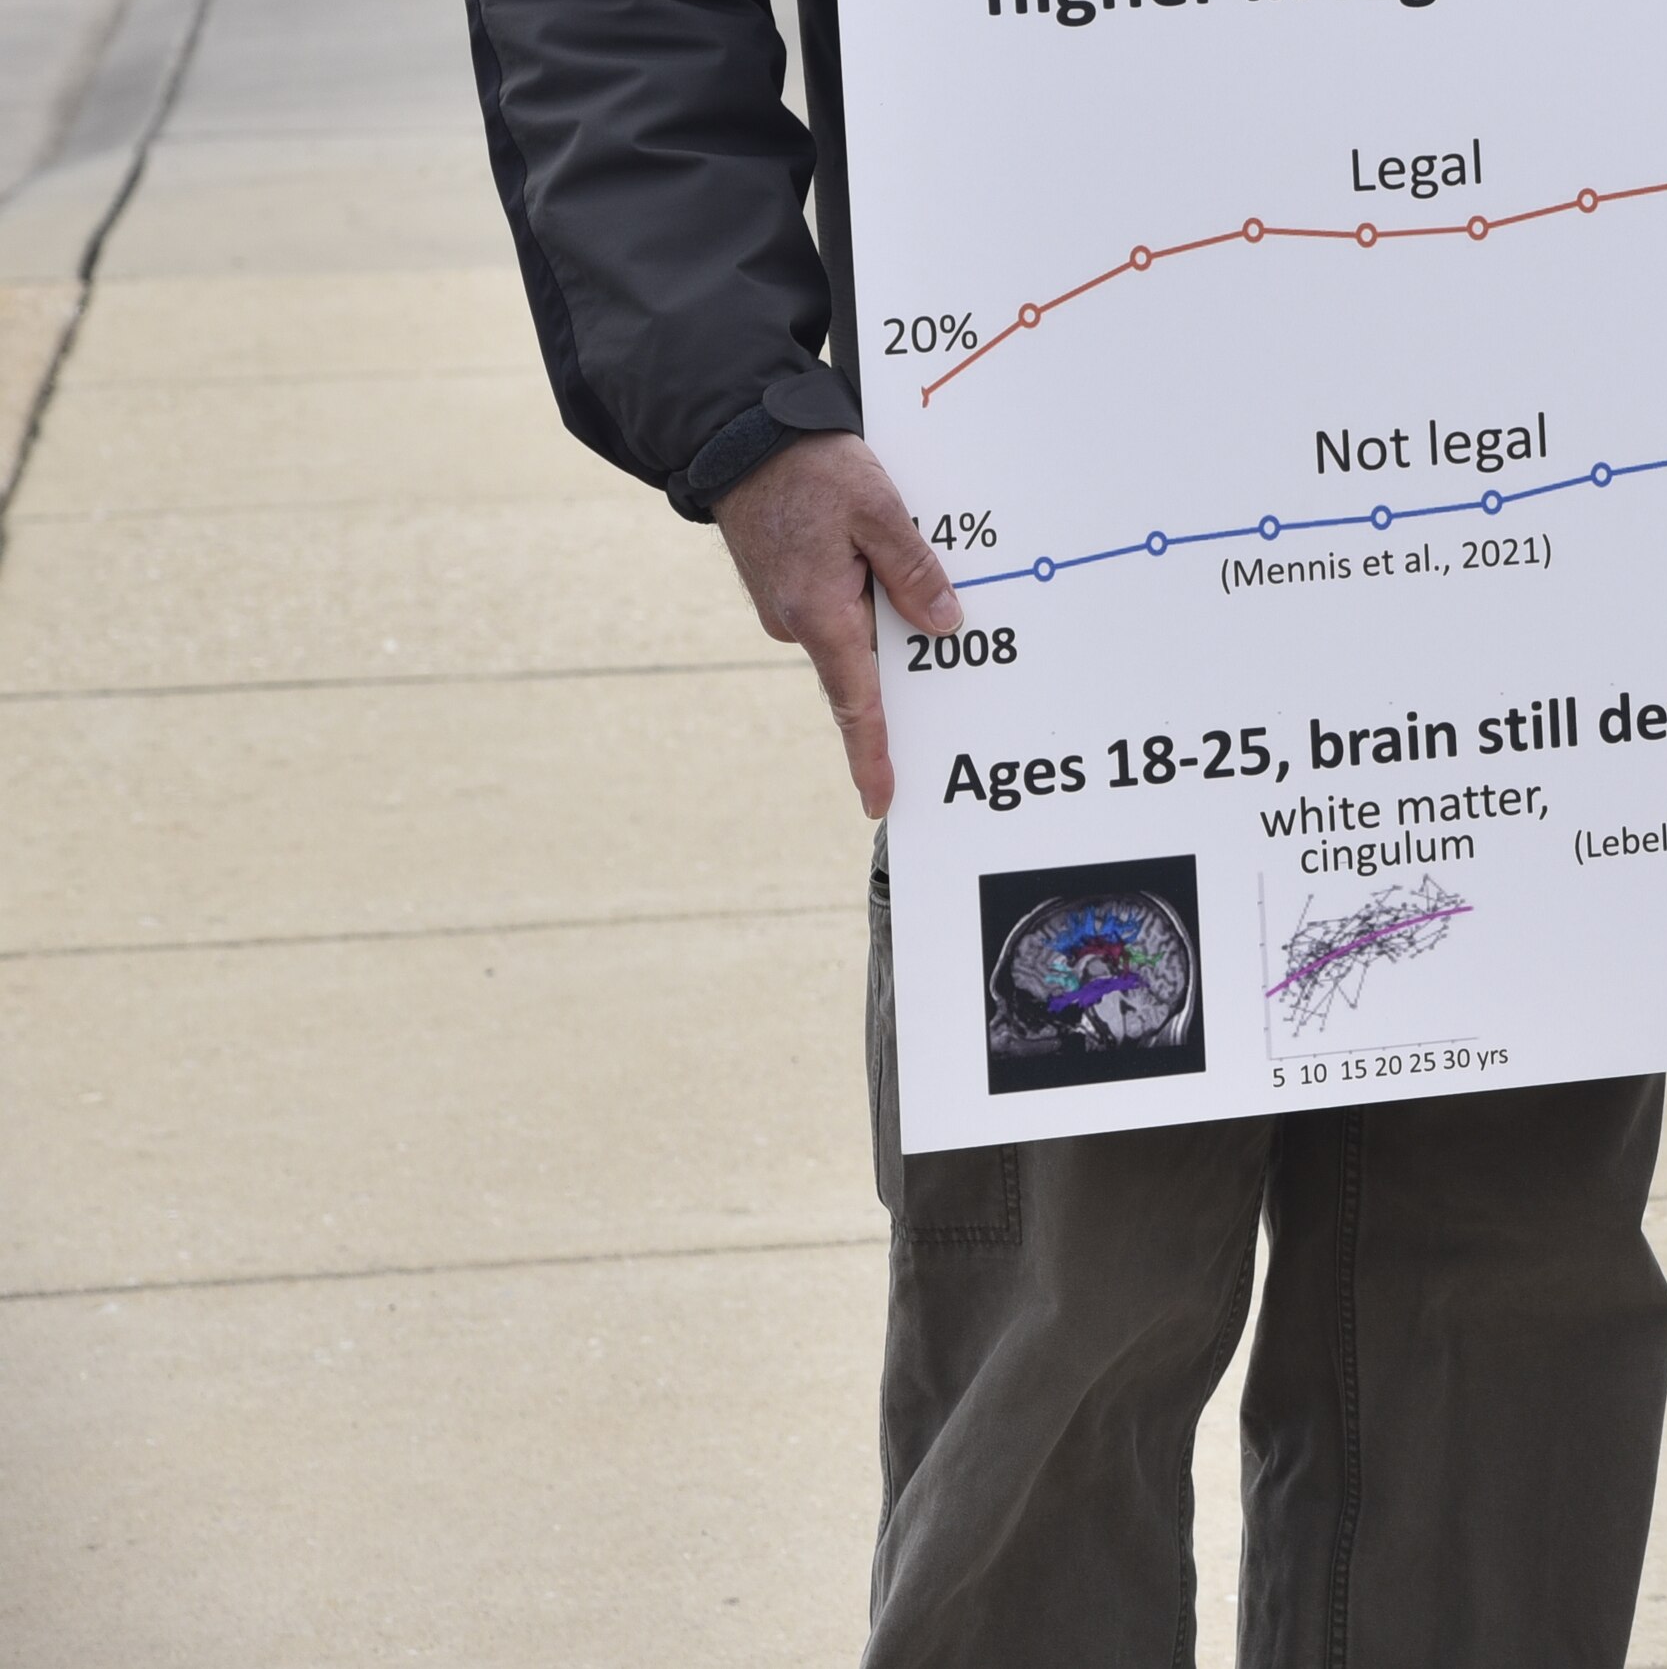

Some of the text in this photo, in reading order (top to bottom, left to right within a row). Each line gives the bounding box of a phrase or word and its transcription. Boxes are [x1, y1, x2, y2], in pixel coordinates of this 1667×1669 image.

[1351, 138, 1482, 200] Legal
[883, 312, 978, 356] 20%
[1315, 411, 1547, 475] Not legal
[1221, 533, 1552, 595] (Mennis et al., 2021)
[907, 627, 1018, 672] 2008
[943, 753, 1086, 812] Ages
[1107, 726, 1290, 788] 18-25,
[1309, 710, 1458, 770] brain
[1478, 696, 1578, 755] still
[1259, 784, 1548, 838] white matter,
[1301, 830, 1474, 877] cingulum
[1574, 822, 1667, 866] (Lebel
[1273, 1048, 1509, 1088] 5 10 15 20 25 30 yrs
